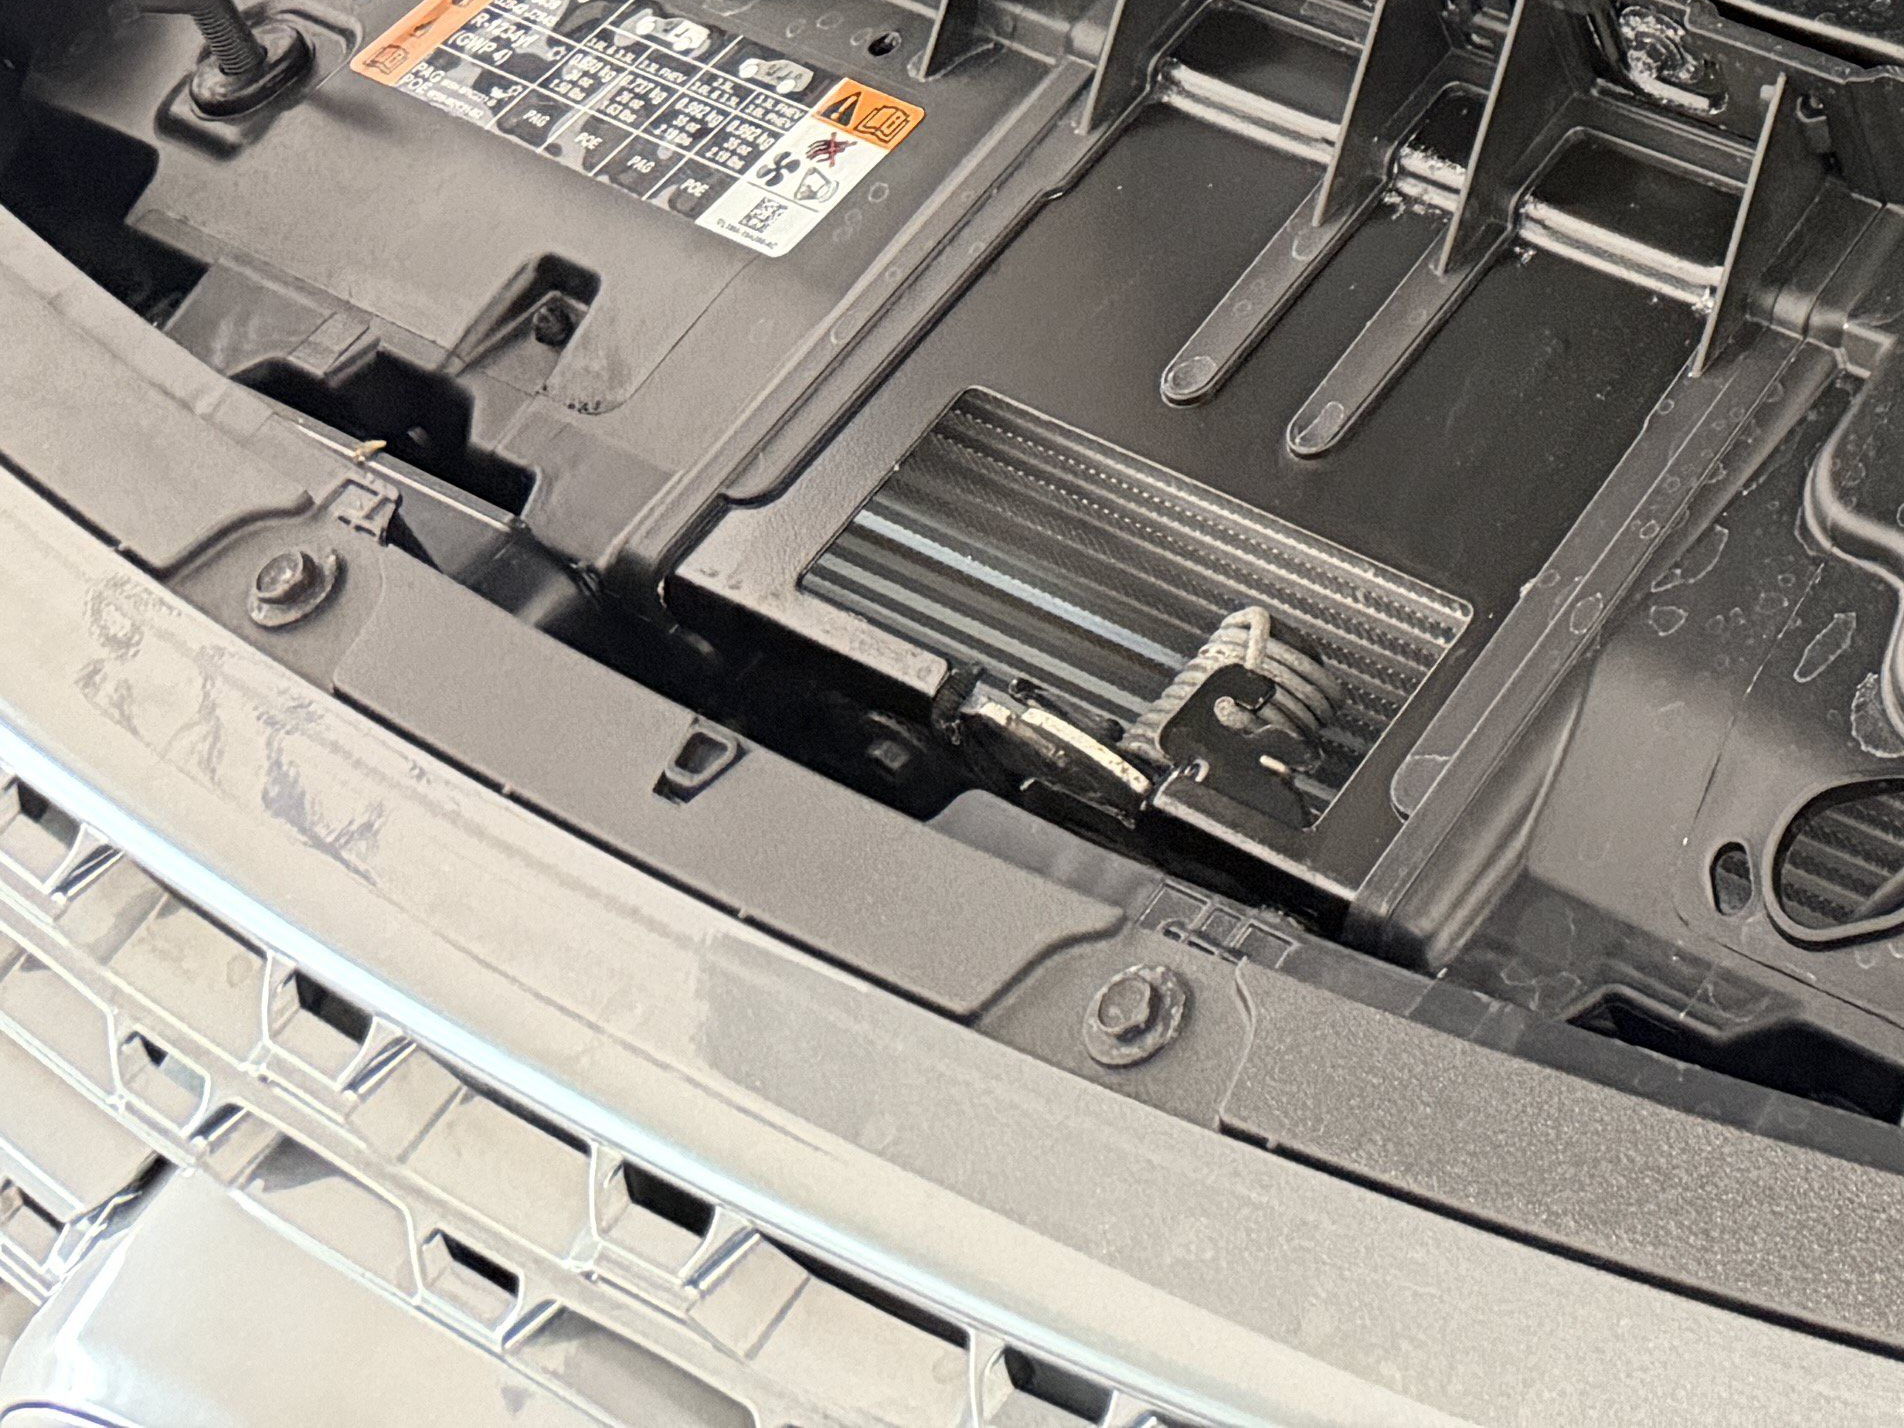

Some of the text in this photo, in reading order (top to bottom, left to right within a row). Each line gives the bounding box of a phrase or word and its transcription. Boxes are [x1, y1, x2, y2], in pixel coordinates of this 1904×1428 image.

[471, 13, 539, 50] R-1234yf
[448, 30, 512, 65] (GWP 4)
[411, 62, 445, 82] PAG
[597, 65, 616, 82] kg
[397, 73, 433, 94] POE
[578, 76, 593, 87] oz
[567, 87, 585, 100] lbs
[648, 86, 667, 104] kg
[628, 99, 644, 109] oz
[674, 97, 723, 127] 0.992 kg
[522, 109, 549, 126] PAG
[618, 109, 636, 122] lbs
[685, 122, 700, 132] oz
[726, 120, 774, 150] 0.992 kg
[574, 132, 602, 148] POE
[672, 132, 692, 146] lbs
[736, 144, 752, 155] oz
[627, 155, 654, 172] PAG
[726, 155, 744, 169] lbs
[680, 178, 708, 196] POE
